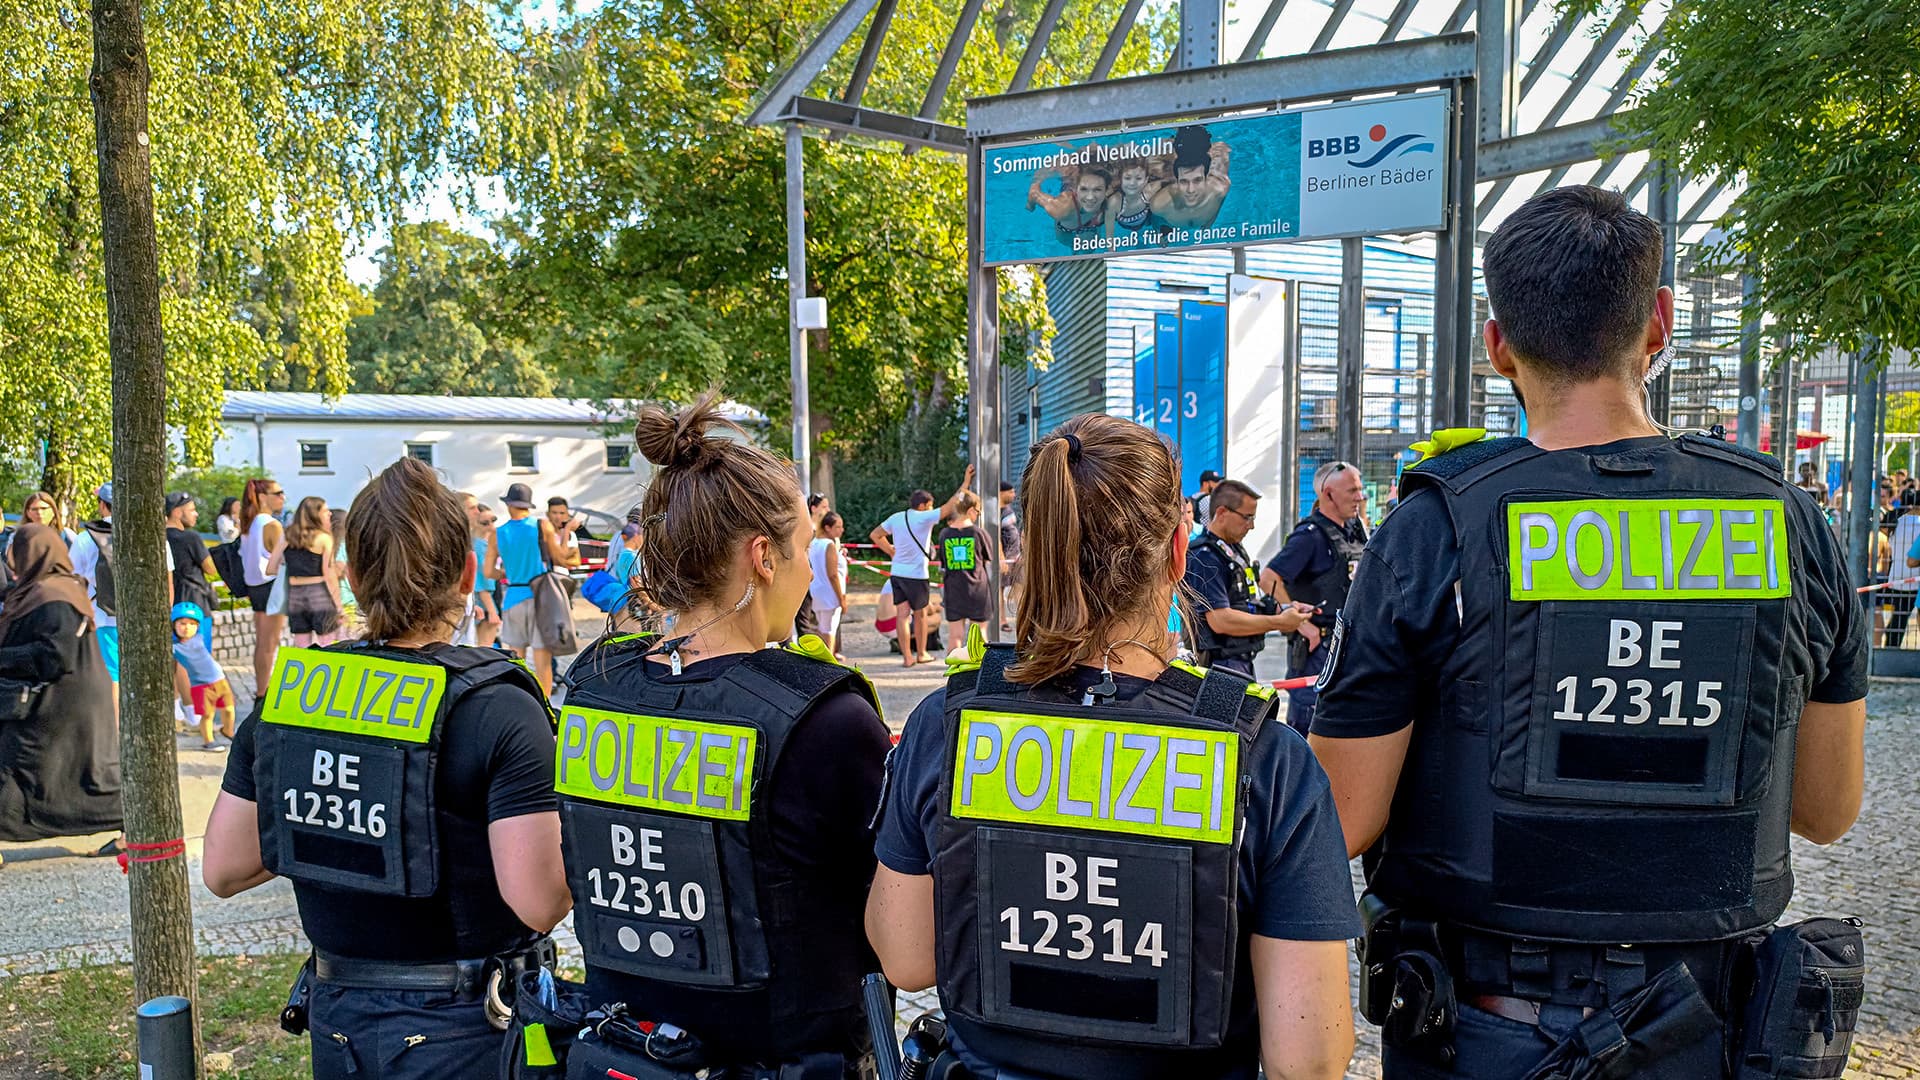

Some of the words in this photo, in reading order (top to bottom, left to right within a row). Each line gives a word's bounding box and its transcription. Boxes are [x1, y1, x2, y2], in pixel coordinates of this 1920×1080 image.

[993, 146, 1090, 174] Sommerbad
[1096, 137, 1173, 163] Neukölln
[1308, 136, 1361, 158] BBB
[1307, 173, 1376, 192] Berliner
[1381, 167, 1434, 185] Bäder
[1073, 231, 1138, 251] Badespaß
[1143, 230, 1164, 244] für
[1167, 228, 1189, 243] die
[1193, 226, 1236, 243] ganze
[1241, 218, 1291, 237] Famile
[1159, 397, 1173, 423] 2
[1183, 391, 1198, 419] 3
[1519, 509, 1780, 591] POLIZEI
[1607, 619, 1684, 669] BE
[273, 659, 435, 729] POLIZEI
[1553, 676, 1723, 727] 12315
[312, 749, 360, 791] BE
[560, 713, 749, 811] POLIZEI
[960, 721, 1227, 832] POLIZEI
[284, 788, 387, 838] 12316
[611, 823, 666, 871] BE
[588, 867, 706, 922] 12310
[1045, 852, 1120, 907] BE
[1000, 907, 1169, 968] 12314
